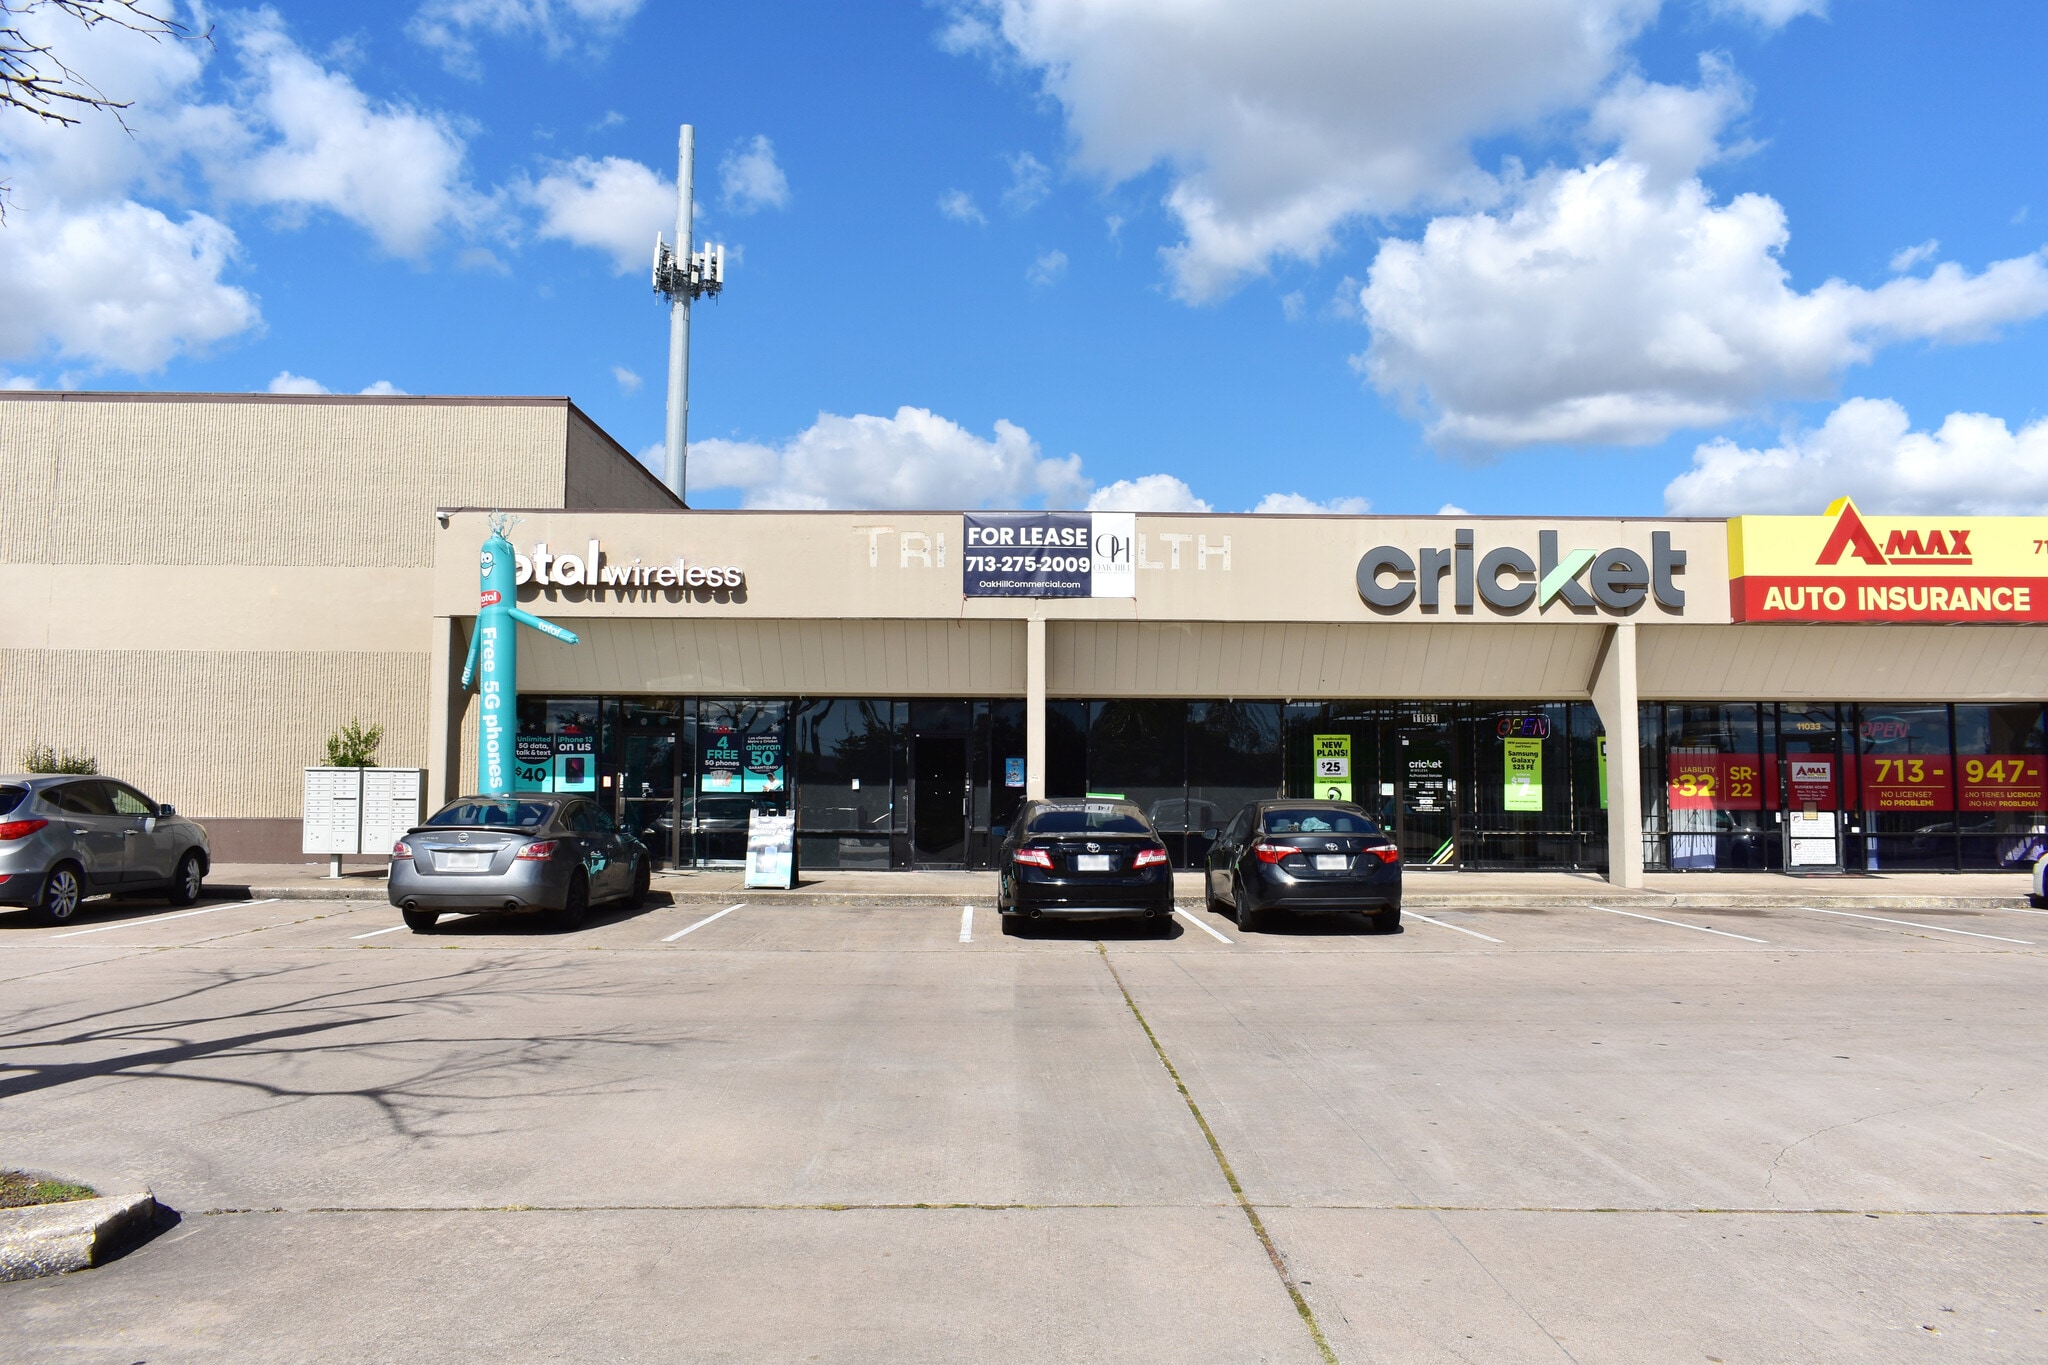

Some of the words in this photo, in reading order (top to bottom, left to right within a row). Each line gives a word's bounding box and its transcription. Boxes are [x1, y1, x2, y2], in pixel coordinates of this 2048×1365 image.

[968, 527, 1014, 546] FOR
[1020, 527, 1088, 546] LEASE
[1138, 532, 1231, 571] LTH
[515, 539, 600, 586] otal
[604, 557, 742, 587] wireless
[966, 556, 1090, 573] 713-275-2009
[1356, 528, 1687, 608] cricket
[980, 580, 1080, 589] OakHillCommercial.com
[480, 592, 497, 603] otal
[1763, 586, 1846, 611] AUTO
[1858, 587, 2031, 611] INSURANCE
[482, 628, 497, 673] Free
[484, 681, 501, 710] 5G
[1413, 714, 1438, 722] 11031
[1497, 718, 1547, 735] OPEN
[1860, 721, 1909, 738] OPEN
[559, 743, 575, 751] on
[577, 743, 592, 751] us
[717, 736, 728, 749] 4
[746, 743, 781, 751] ahorran
[483, 714, 503, 788] phones
[707, 750, 738, 759] FREE
[1321, 762, 1340, 772] $25
[1409, 760, 1443, 768] cricket
[515, 766, 547, 782] $40
[1730, 767, 1757, 780] SR-
[1672, 774, 1716, 797] $32
[1731, 783, 1753, 797] 22
